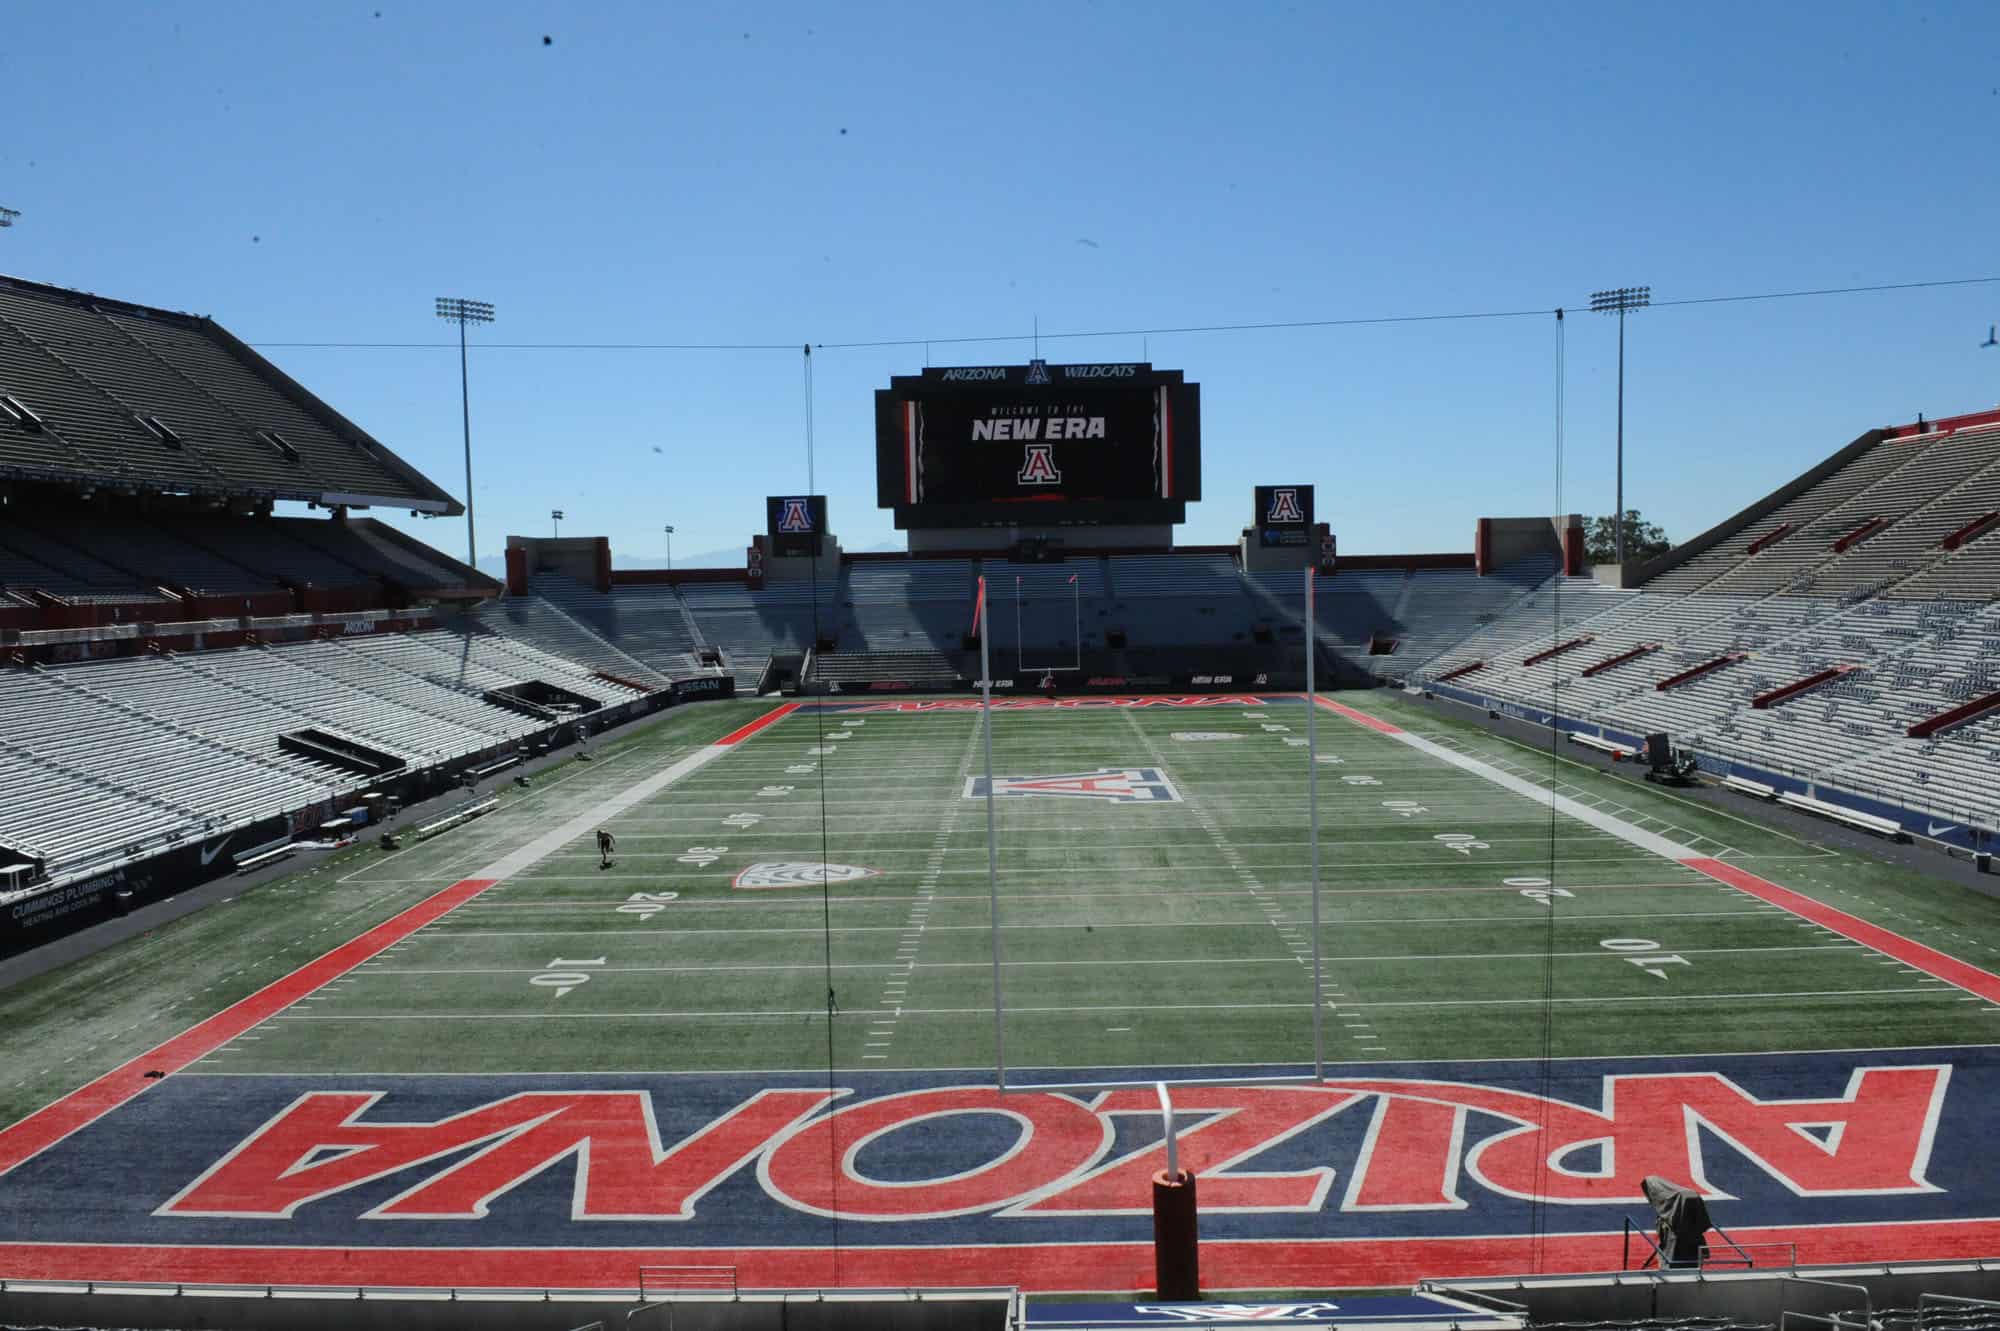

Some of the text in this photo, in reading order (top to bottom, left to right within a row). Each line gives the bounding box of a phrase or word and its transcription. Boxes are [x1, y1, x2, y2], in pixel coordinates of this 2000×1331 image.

[942, 367, 1006, 381] ARIZONA
[1064, 365, 1136, 377] WILDCATS
[971, 417, 1105, 440] NEW ERA
[1017, 444, 1061, 485] A
[778, 499, 815, 533] A
[1267, 489, 1304, 523] A
[344, 621, 376, 634] ARIZONA
[1433, 833, 1491, 849] 30
[676, 846, 729, 862] 30
[66, 874, 115, 900] PLUMBING
[1502, 877, 1577, 899] 20
[615, 891, 680, 913] 20
[1599, 938, 1692, 967] 10
[528, 955, 608, 987] 10
[151, 1063, 1954, 1226] ARIZONA
